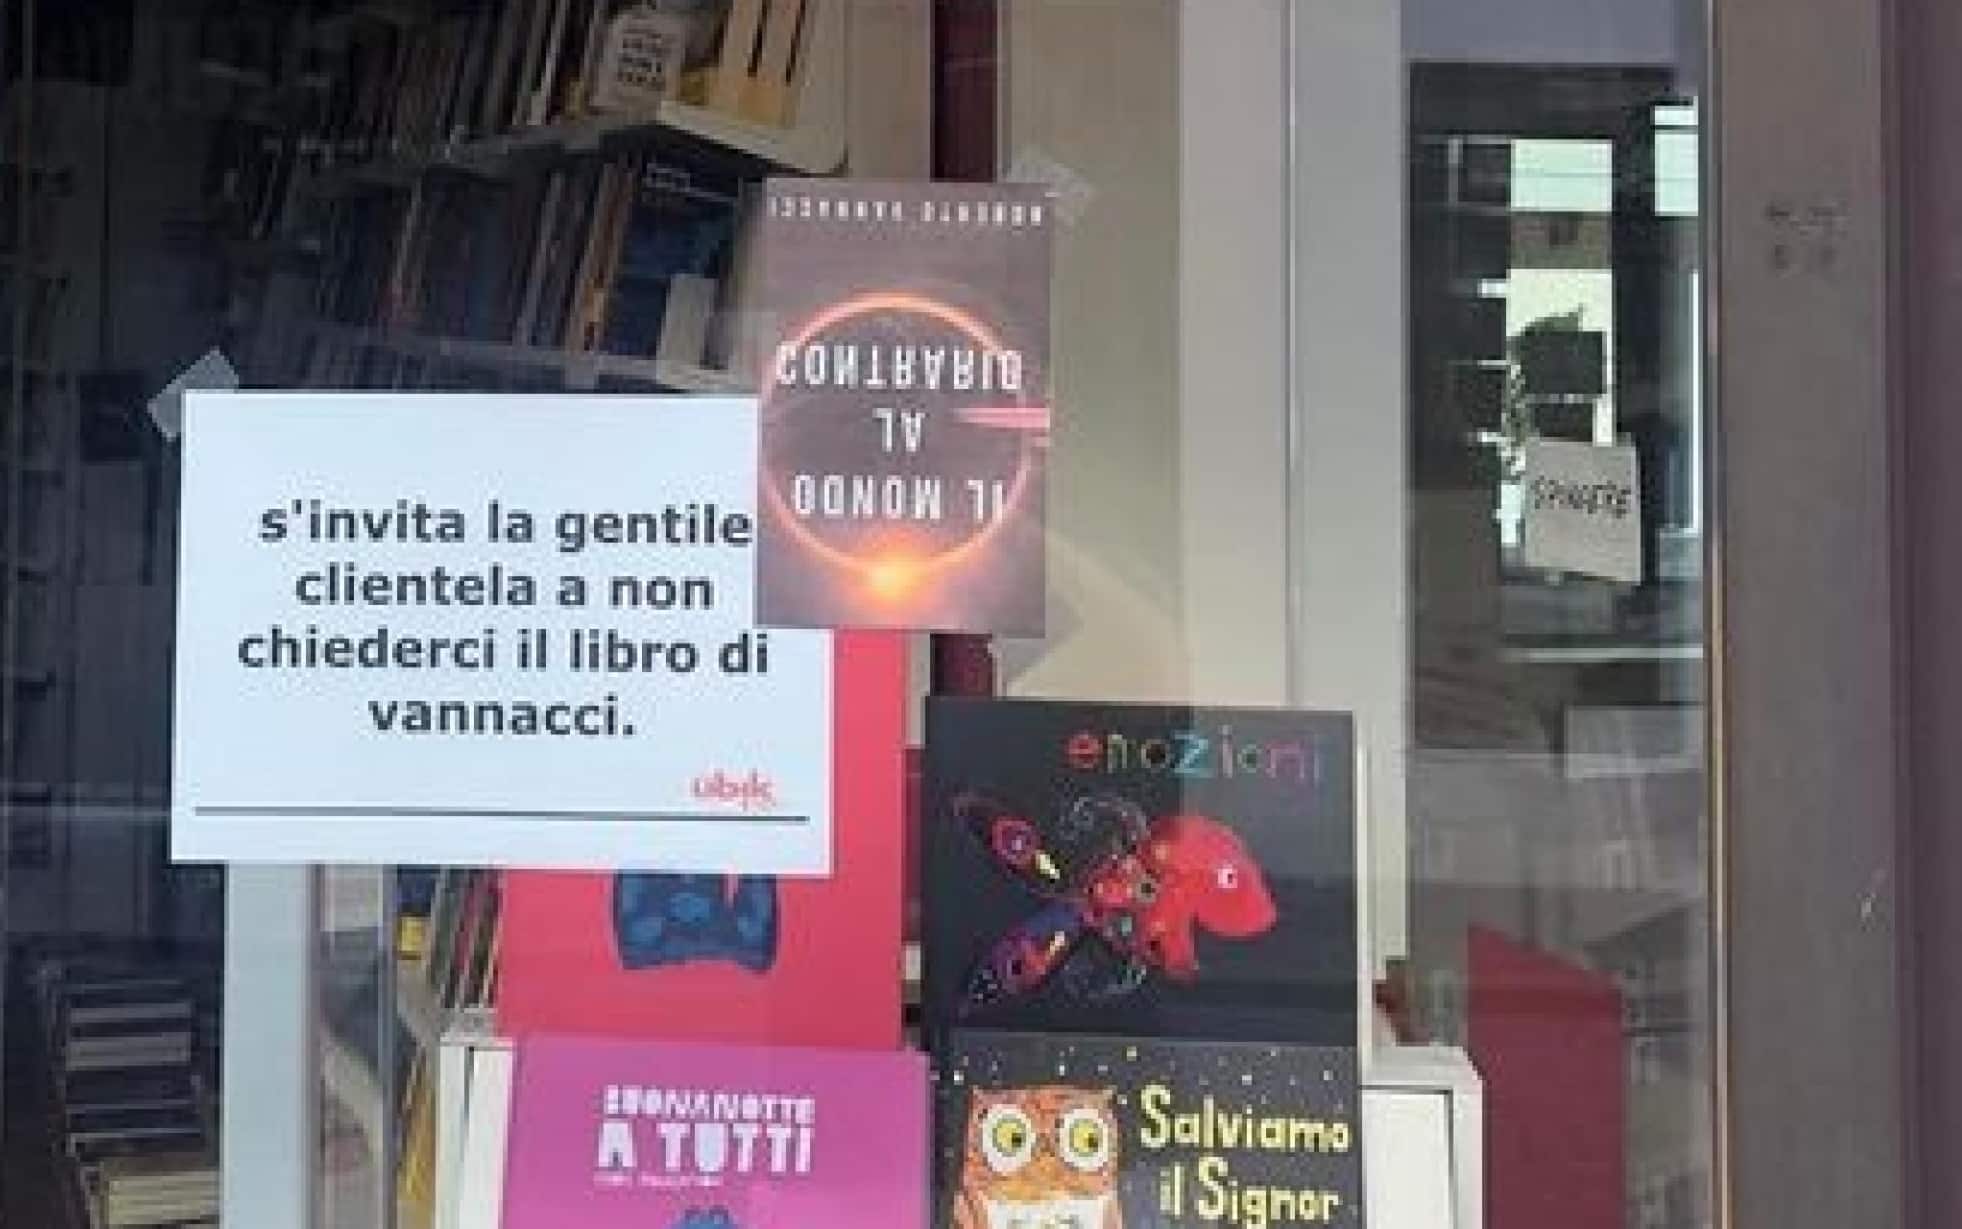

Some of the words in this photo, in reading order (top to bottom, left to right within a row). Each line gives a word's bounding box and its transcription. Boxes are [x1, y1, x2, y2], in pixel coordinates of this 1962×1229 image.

[775, 344, 1022, 391] CONTRARIO
[873, 408, 925, 453] AL
[795, 474, 942, 520] MONDO
[968, 479, 1004, 520] IL
[260, 499, 466, 544] s'invita
[488, 500, 534, 544] la
[554, 504, 753, 552] gentile
[295, 562, 537, 607] clientela
[558, 575, 587, 607] a
[611, 575, 714, 610] non
[237, 625, 496, 669] chiederci
[516, 628, 548, 669] il
[569, 629, 698, 673] libro
[717, 633, 769, 674] di
[367, 693, 635, 736] vannacci.
[1139, 1083, 1350, 1152] Salviamo
[598, 1120, 636, 1168] A
[658, 1122, 813, 1173] TUTTI
[1160, 1161, 1184, 1214] il
[1194, 1156, 1343, 1229] Signor
